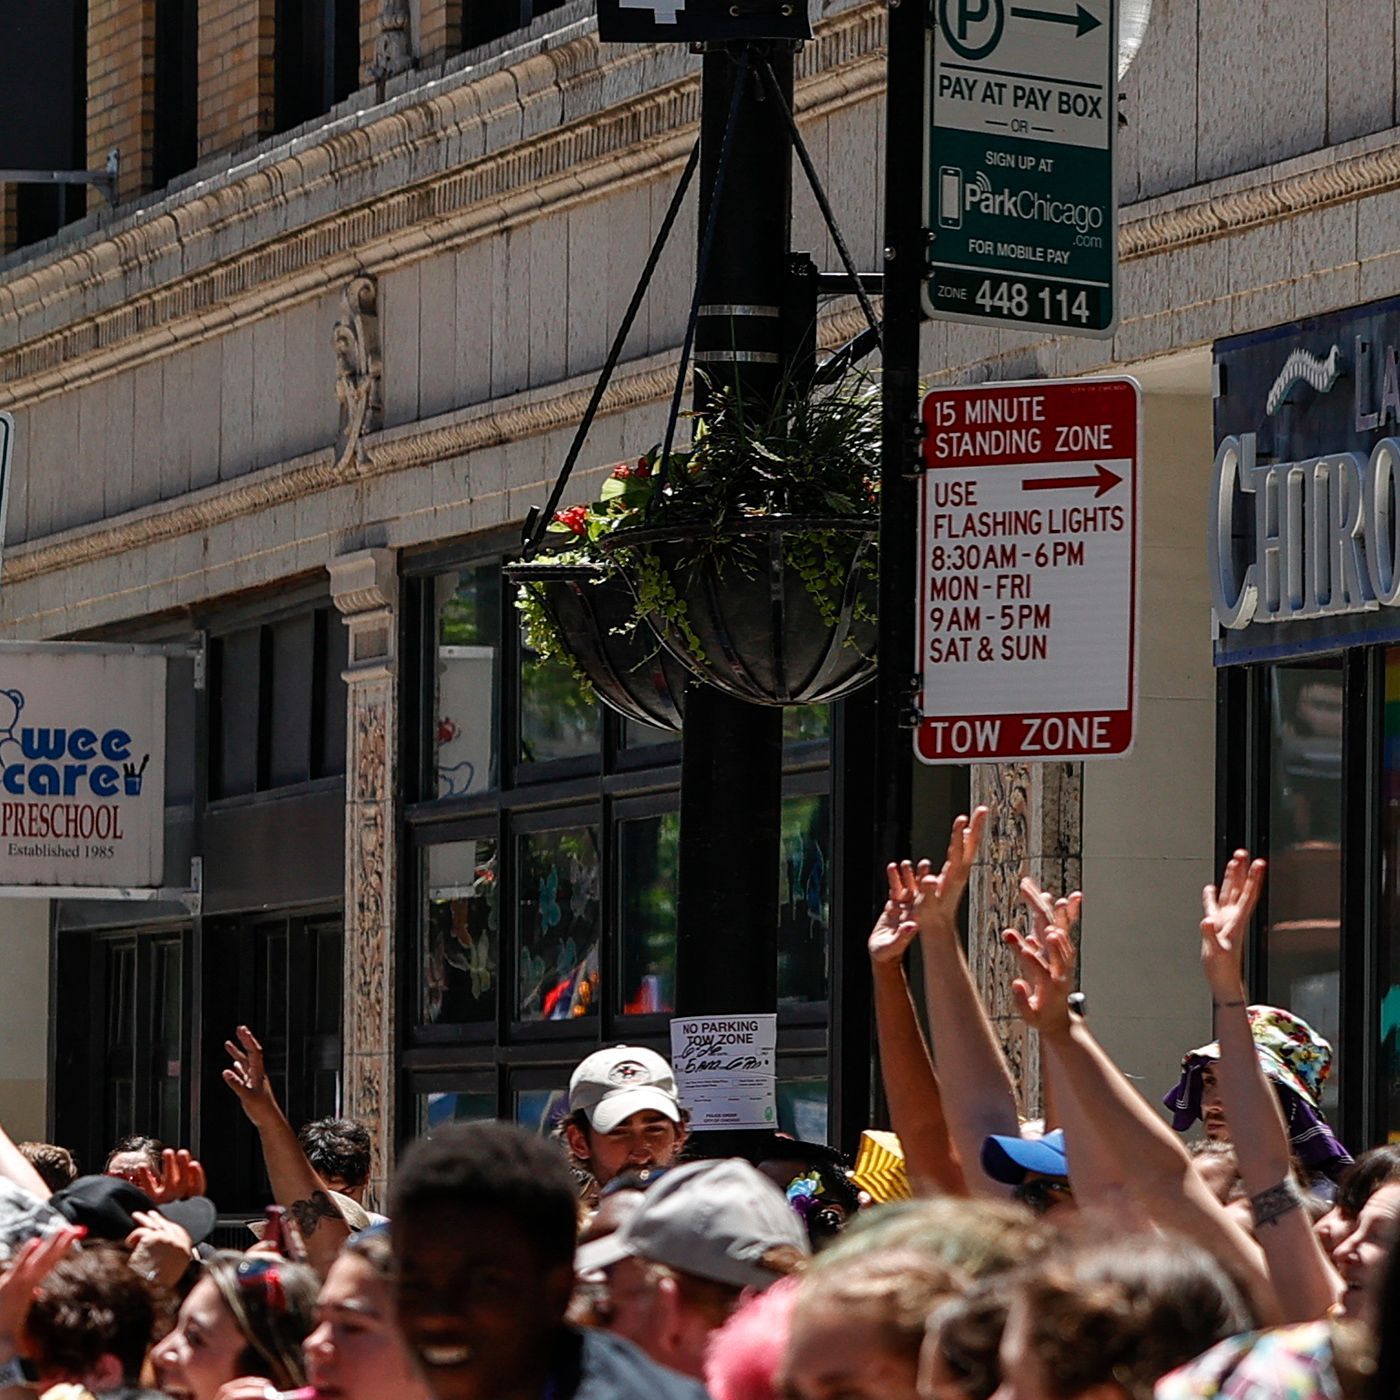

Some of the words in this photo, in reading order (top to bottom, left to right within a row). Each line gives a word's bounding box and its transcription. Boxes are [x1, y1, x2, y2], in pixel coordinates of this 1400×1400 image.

[939, 75, 977, 101] PAY
[981, 81, 1006, 105] AT
[1013, 85, 1052, 111] PAY
[1058, 92, 1102, 119] BOX
[1010, 119, 1028, 133] OR
[985, 151, 1015, 168] SIGN
[1018, 155, 1035, 169] UP
[1038, 159, 1054, 172] AT
[964, 183, 1102, 233] ParkChicago
[968, 239, 994, 255] FOR
[997, 243, 1044, 261] MOBILE
[1047, 249, 1070, 264] PAY
[1072, 234, 1102, 248] .com
[938, 285, 968, 300] ZONE
[975, 280, 1029, 317] 448
[1038, 287, 1090, 323] 114
[935, 401, 955, 426] 15
[965, 396, 1046, 424] MINUTE
[935, 428, 1041, 458] STANDING
[1055, 425, 1113, 451] ZONE
[935, 481, 977, 507] USE
[934, 508, 1042, 539] FLASHING
[1048, 506, 1124, 534] LIGHTS
[929, 637, 972, 663] SAT
[977, 636, 994, 661] &
[1001, 635, 1047, 660] SUN
[21, 728, 131, 761] wee
[930, 720, 1001, 753] TOW
[1020, 716, 1111, 751] ZONE
[2, 763, 120, 796] care
[1, 802, 123, 839] PRESCHOOL
[8, 843, 80, 858] Established
[84, 844, 114, 859] 1985
[683, 1023, 698, 1035] NO
[701, 1021, 758, 1033] PARKING
[687, 1035, 714, 1046] TOW
[719, 1033, 754, 1045] ZONE
